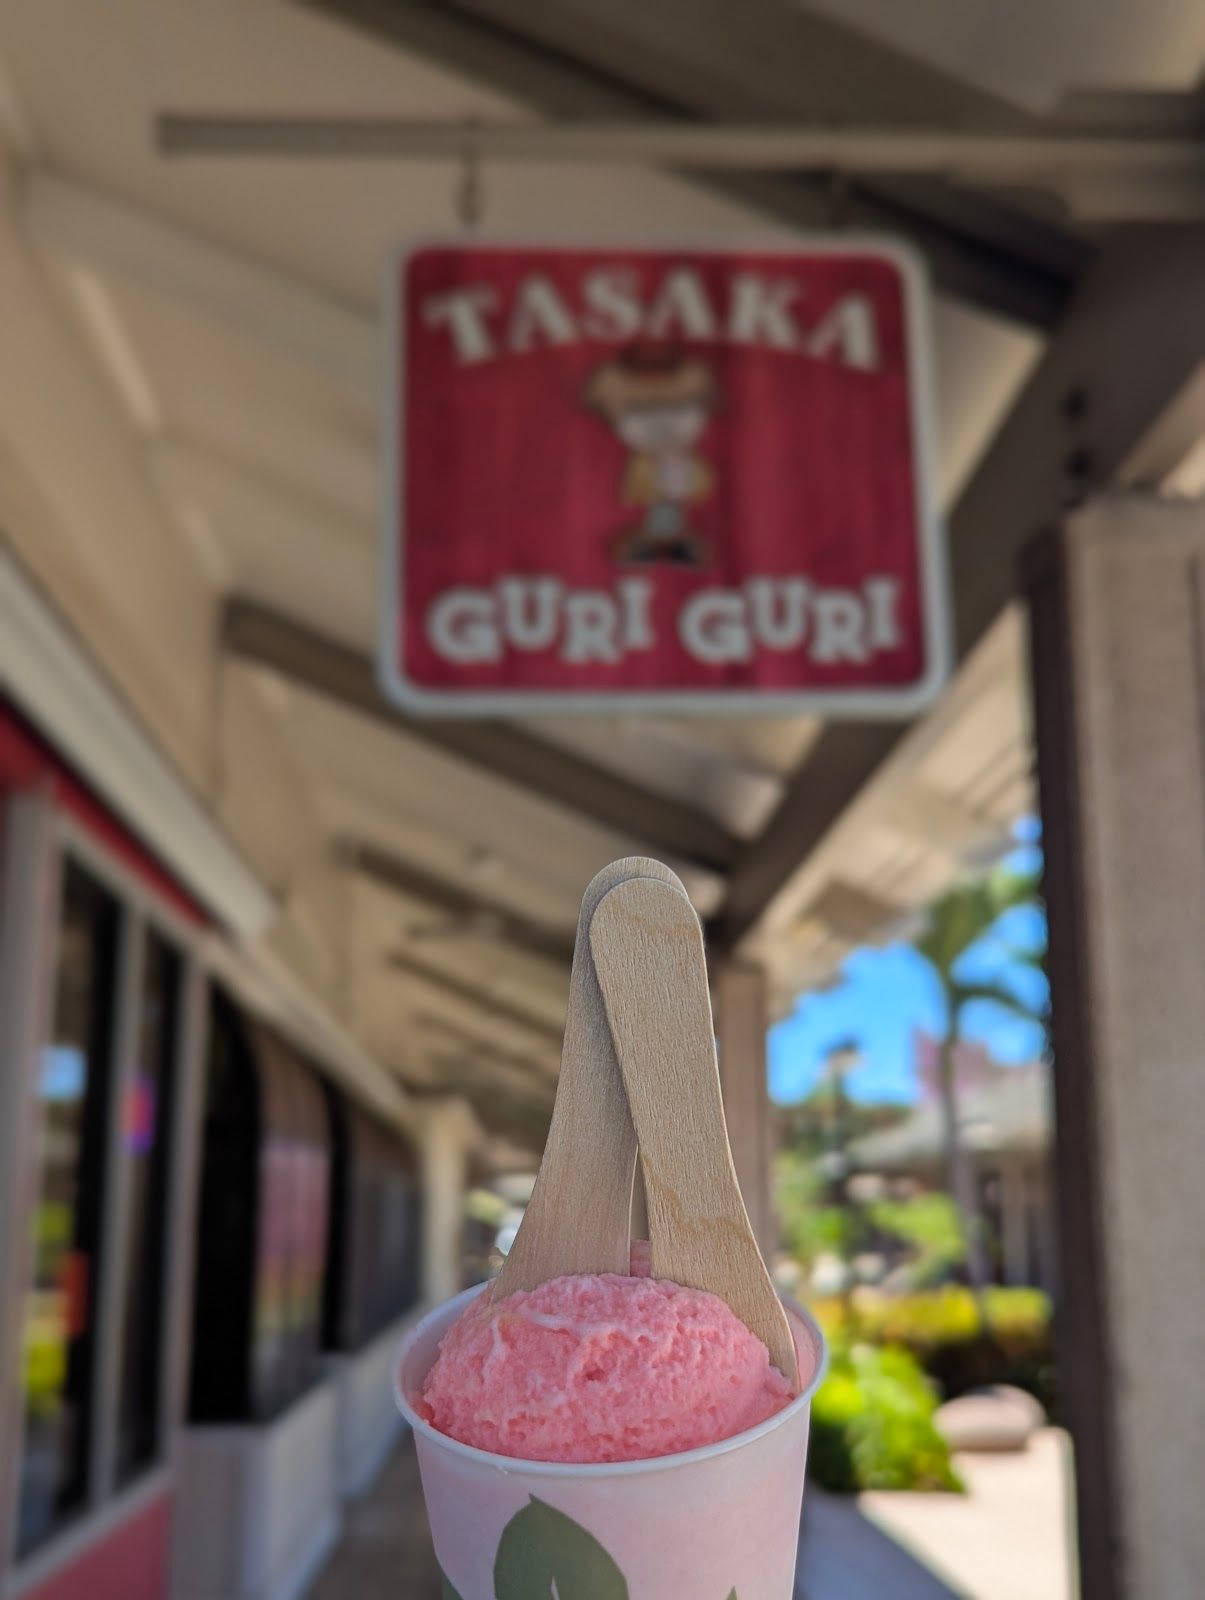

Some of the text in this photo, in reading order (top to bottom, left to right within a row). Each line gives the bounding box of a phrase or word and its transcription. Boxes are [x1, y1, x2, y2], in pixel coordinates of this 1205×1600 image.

[422, 266, 880, 372] TASAKA
[427, 575, 903, 665] GURI GURI
